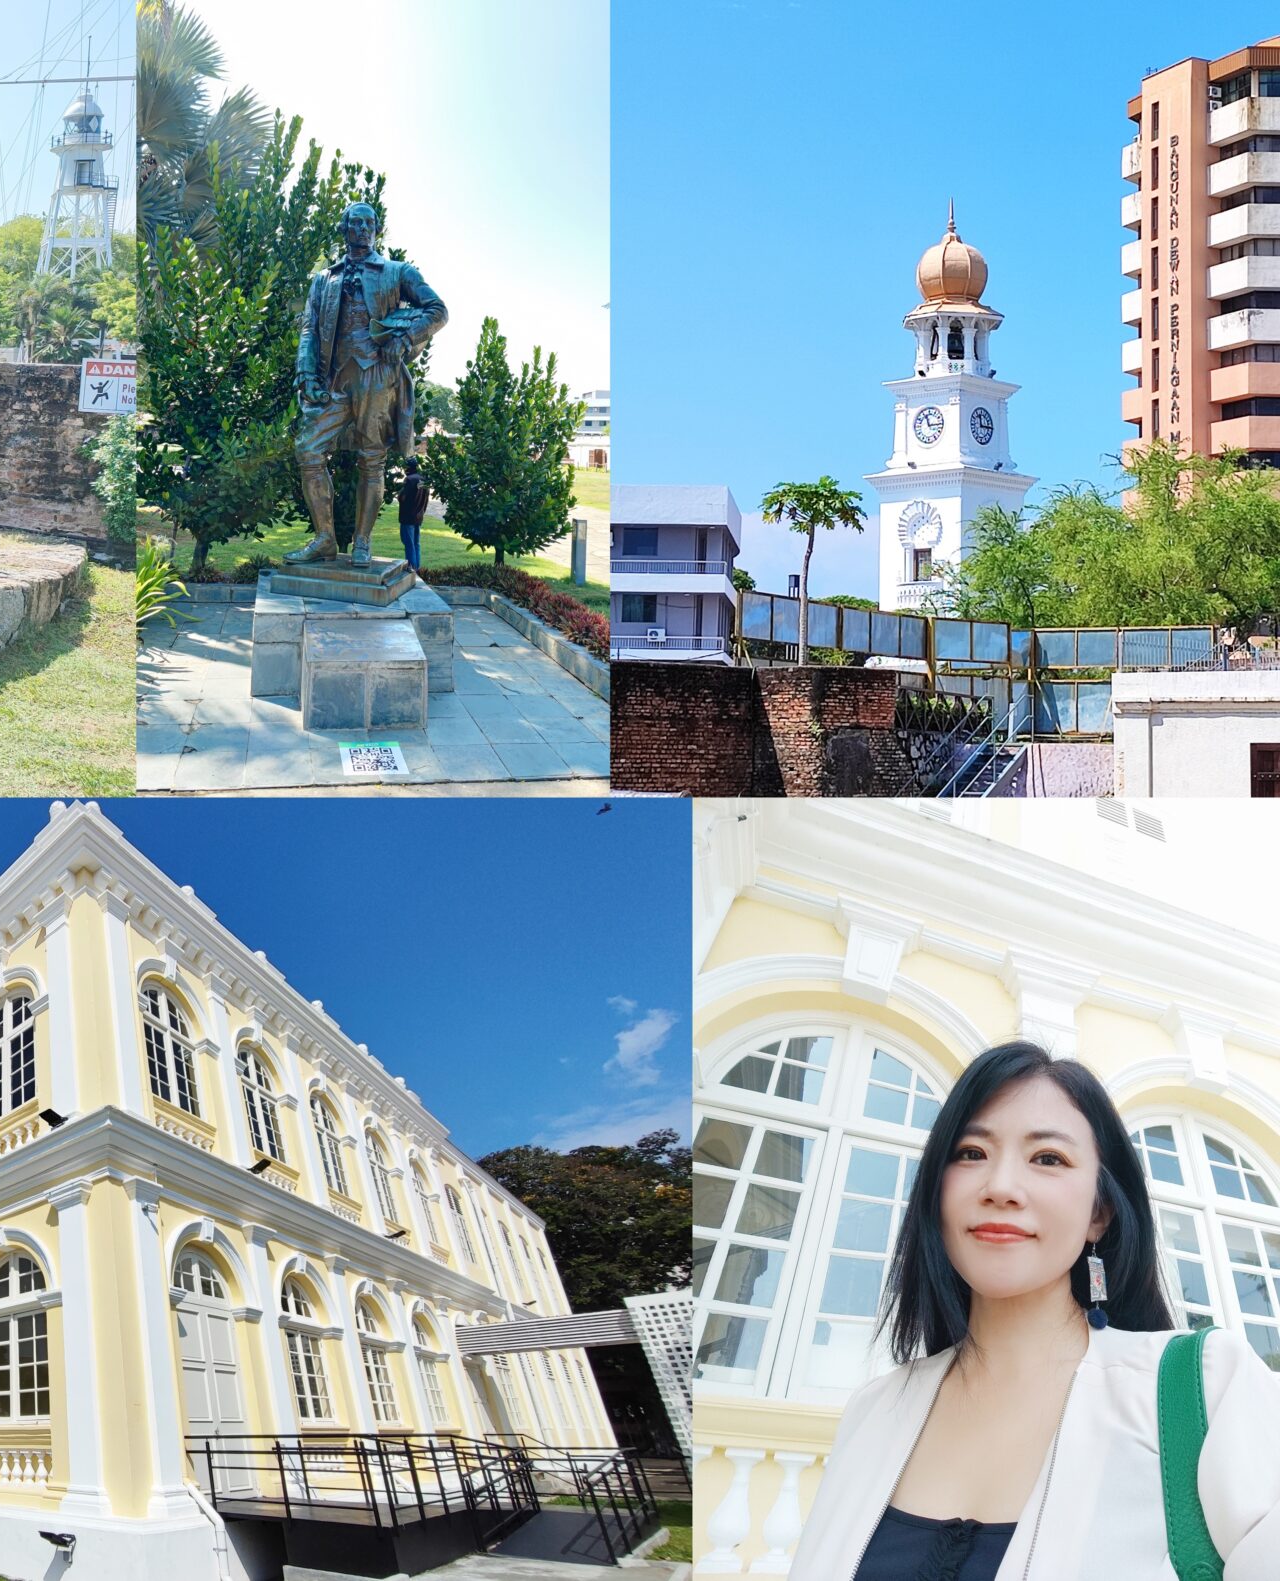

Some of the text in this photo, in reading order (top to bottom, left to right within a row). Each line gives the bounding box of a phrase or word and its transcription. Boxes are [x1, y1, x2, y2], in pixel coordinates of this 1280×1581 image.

[1170, 135, 1179, 230] BANGUNAN
[1169, 237, 1180, 296] DEWAN
[1170, 303, 1180, 424] PERNIAGAAN
